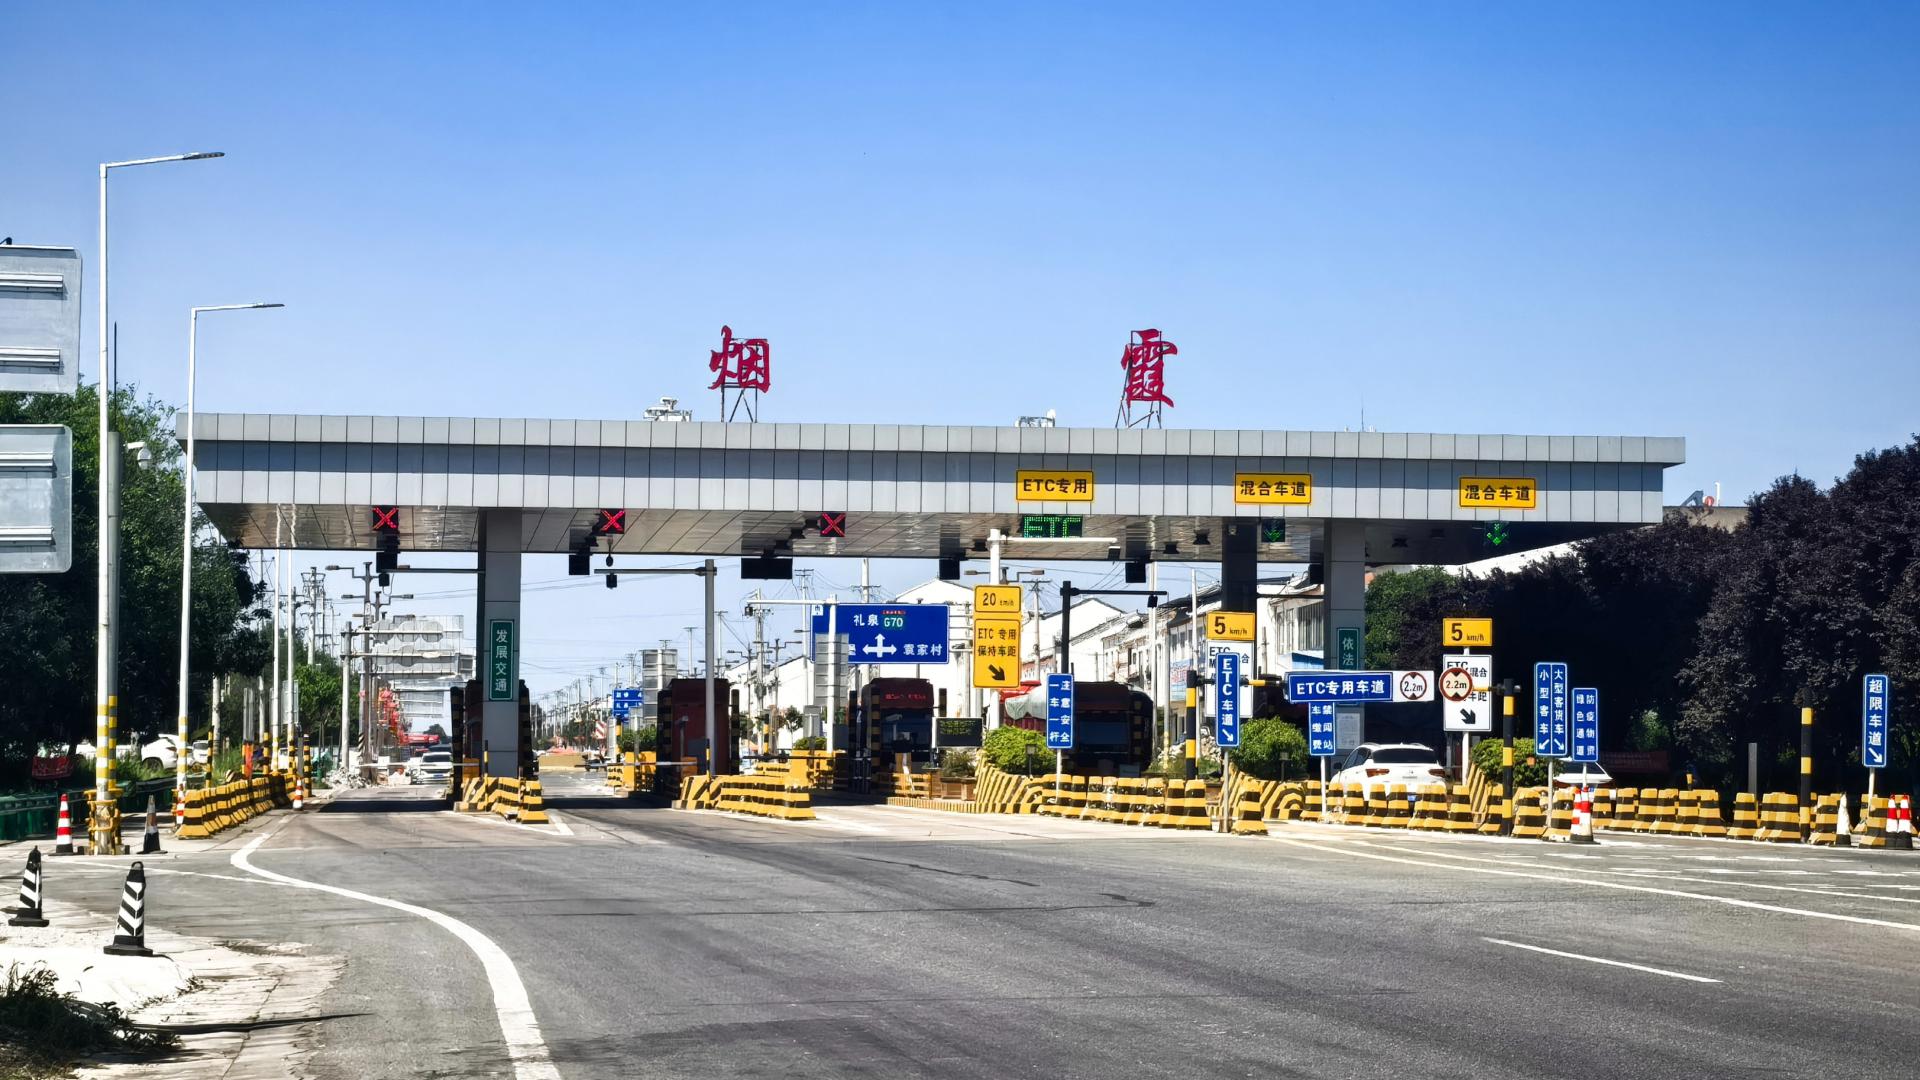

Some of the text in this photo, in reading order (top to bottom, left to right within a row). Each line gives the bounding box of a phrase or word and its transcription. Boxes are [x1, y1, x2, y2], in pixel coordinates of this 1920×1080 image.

[707, 325, 770, 393] 烟
[1023, 478, 1088, 494] ETC专用
[1239, 480, 1307, 497] 混合车道
[1464, 484, 1530, 501] 混合车道
[1023, 515, 1082, 538] ETC
[982, 592, 996, 606] 20
[853, 613, 879, 627] 礼泉
[884, 617, 904, 628] G70
[1214, 616, 1248, 635] 5 km/h
[977, 628, 1017, 641] ETC 专用
[1451, 622, 1485, 642] 5 km/h
[977, 645, 1017, 657] 保持车距
[495, 629, 508, 692] 发展交通
[1221, 658, 1234, 727] ETC车道
[1296, 679, 1385, 696] ETC专用车道
[1404, 680, 1423, 692] 2.2m
[1445, 680, 1467, 690] 2.2m
[1539, 668, 1549, 735] 小型客车
[1554, 668, 1564, 735] 大型客货车
[1049, 683, 1060, 743] 一车一杆
[1060, 680, 1071, 743] 注意安全
[1868, 679, 1883, 746] 超限车道
